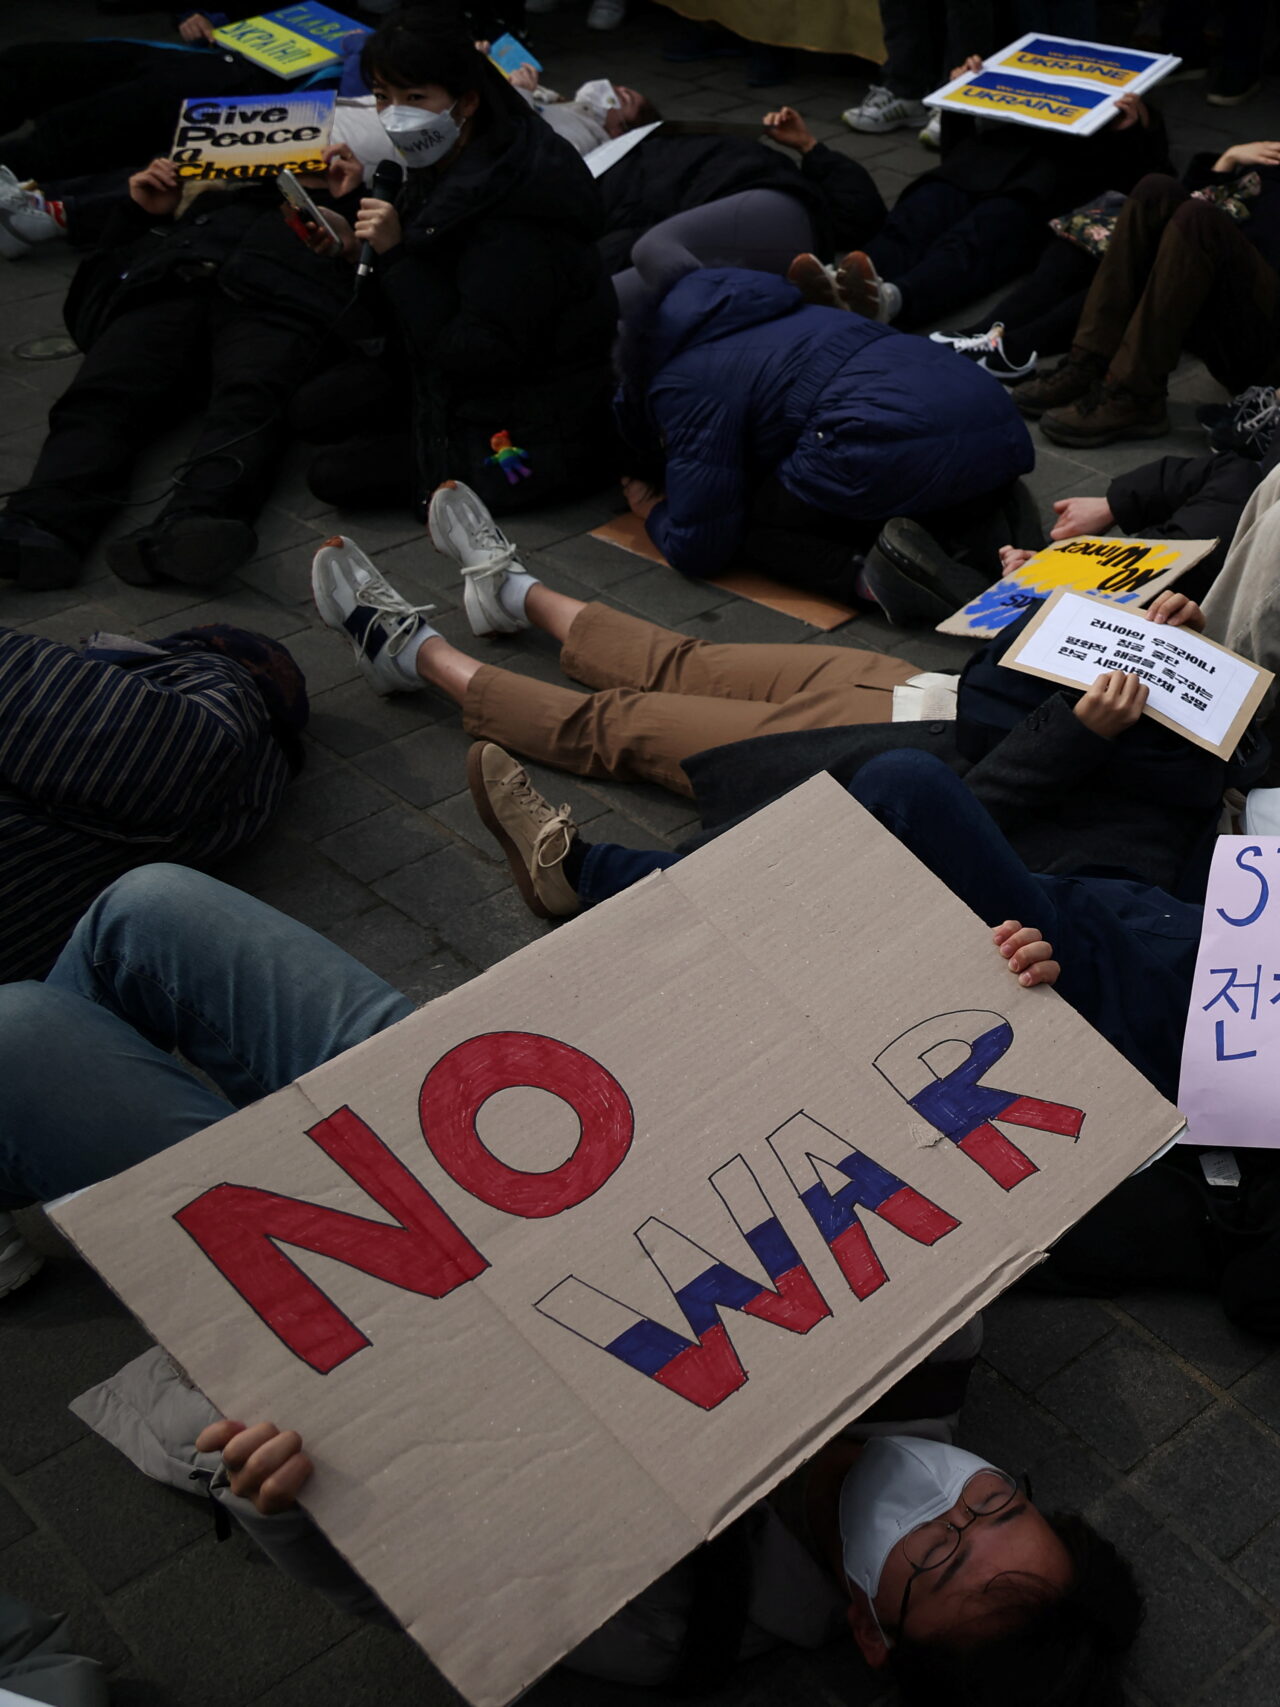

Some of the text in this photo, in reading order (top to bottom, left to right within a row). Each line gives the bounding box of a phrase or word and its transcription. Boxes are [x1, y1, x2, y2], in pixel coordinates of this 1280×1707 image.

[1017, 54, 1130, 80] UKRAINE
[184, 102, 289, 125] Give
[963, 87, 1078, 117] UKRAINE
[176, 126, 321, 148] Peace
[173, 148, 202, 163] a
[177, 159, 329, 180] Chance
[1054, 541, 1152, 569] Winner
[1097, 568, 1171, 593] NO
[1090, 618, 1217, 675] 러시아의 우크라이나
[1117, 638, 1180, 667] 침공 중단
[1058, 646, 1208, 711] 한국 시민사회단체 성명
[1065, 636, 1214, 701] 평화적 해결을 촉구하는
[171, 1030, 635, 1374] NO
[532, 1009, 1086, 1411] WAR
